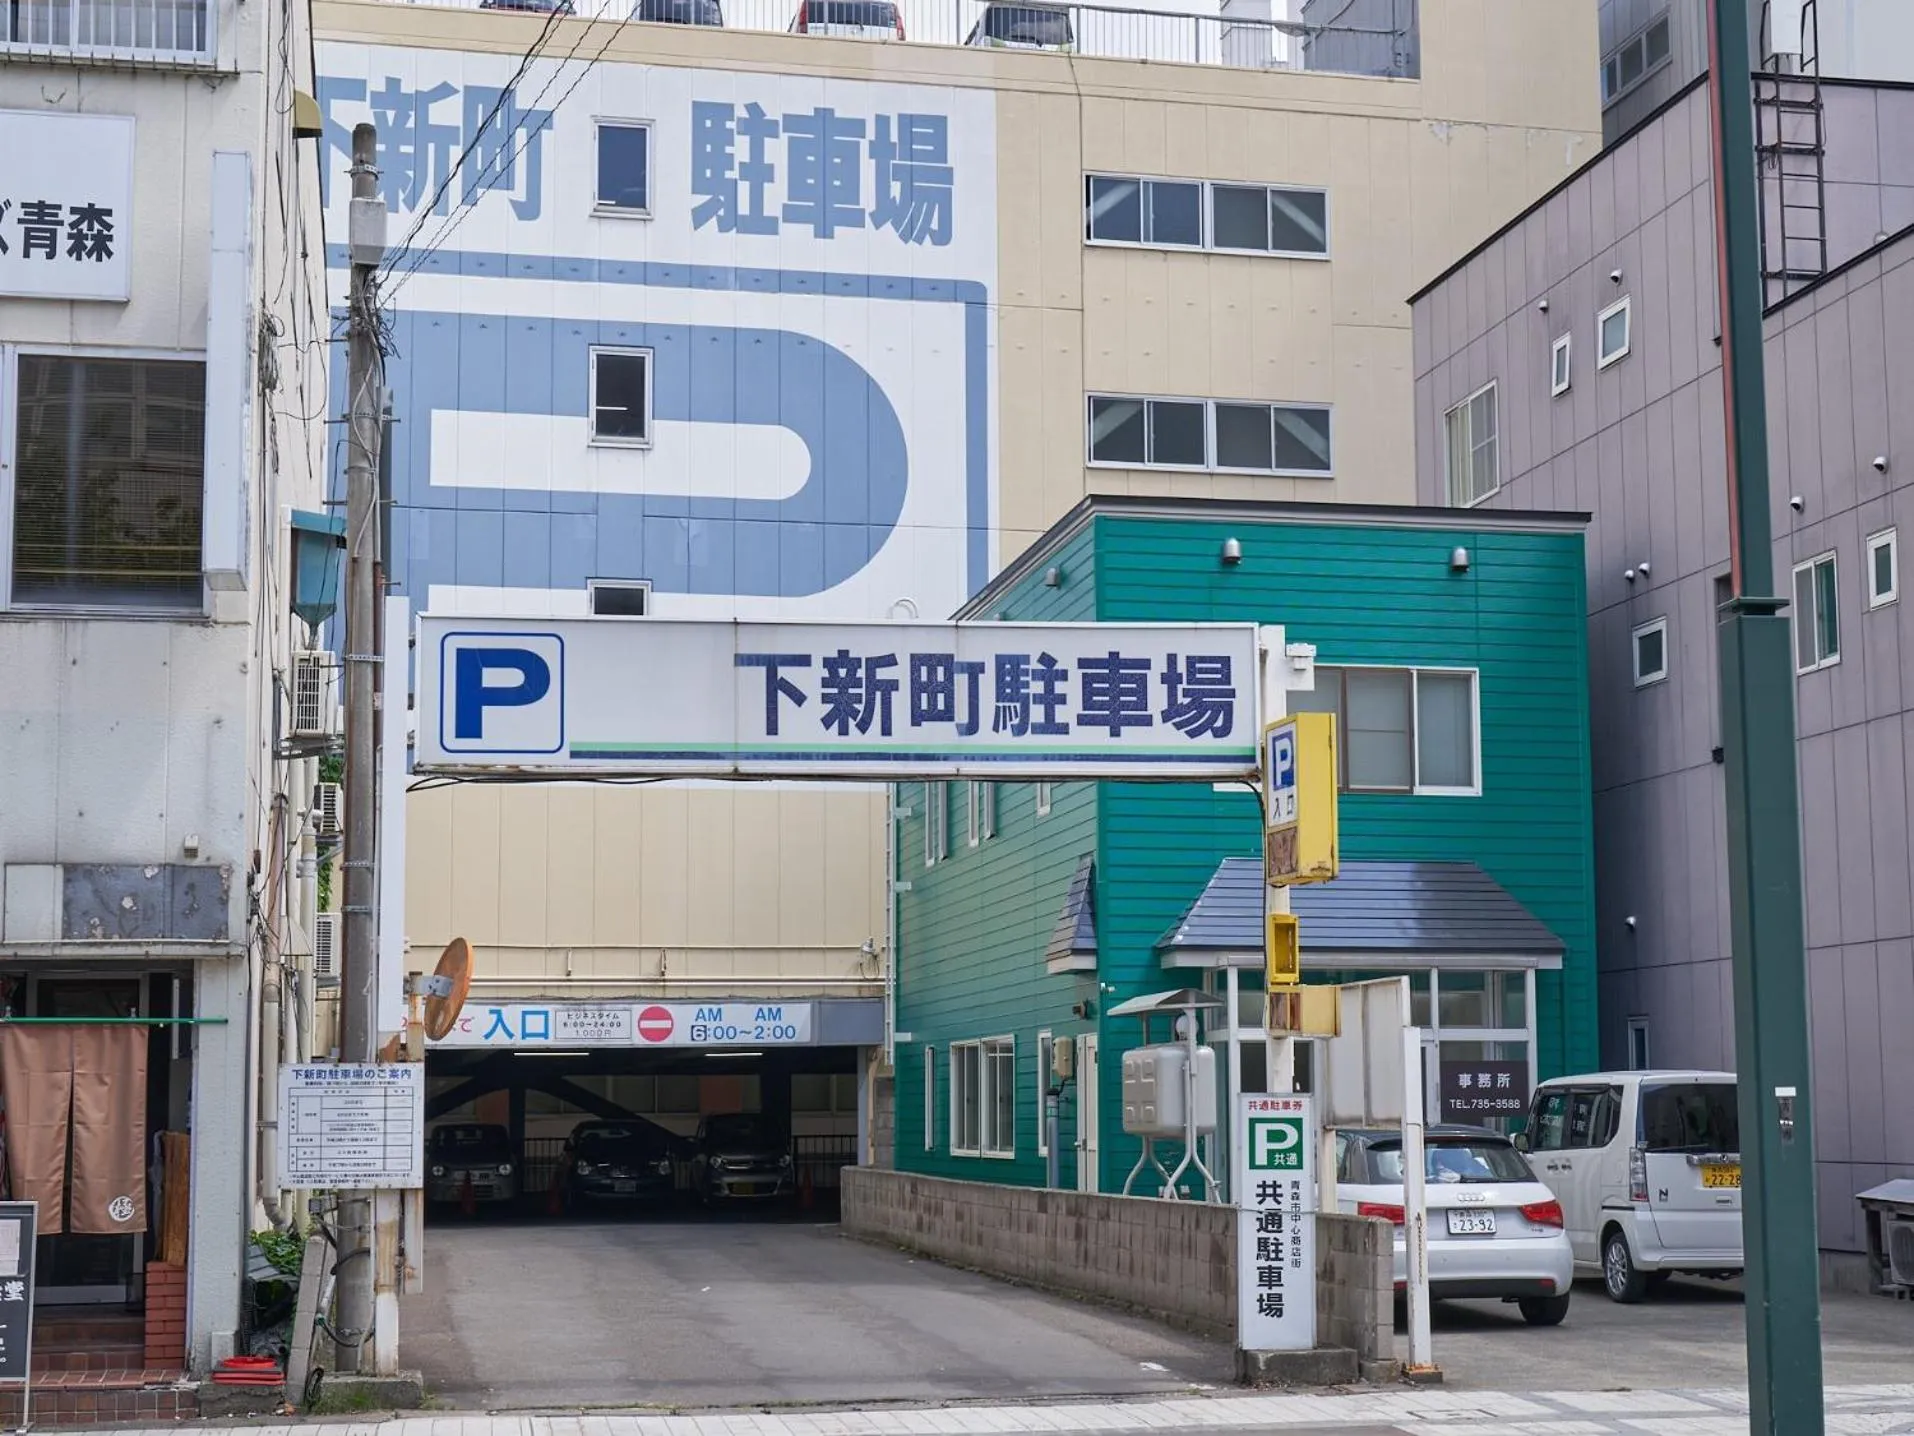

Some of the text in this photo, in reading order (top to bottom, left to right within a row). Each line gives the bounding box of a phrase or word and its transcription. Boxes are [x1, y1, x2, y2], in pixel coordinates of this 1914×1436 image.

[691, 100, 953, 246] 駐車場
[0, 198, 114, 262] 青森
[455, 648, 1236, 739] P 下新町駐車場
[1275, 736, 1293, 787] P
[483, 1008, 549, 1040] 入口
[695, 1007, 782, 1021] AM AM
[292, 1069, 412, 1080] 下新町駐車場のご案内
[1458, 1073, 1511, 1088] 事務所
[1255, 1123, 1299, 1165] P
[1274, 1153, 1298, 1166] 共通
[1256, 1180, 1284, 1318] 共通駐車場
